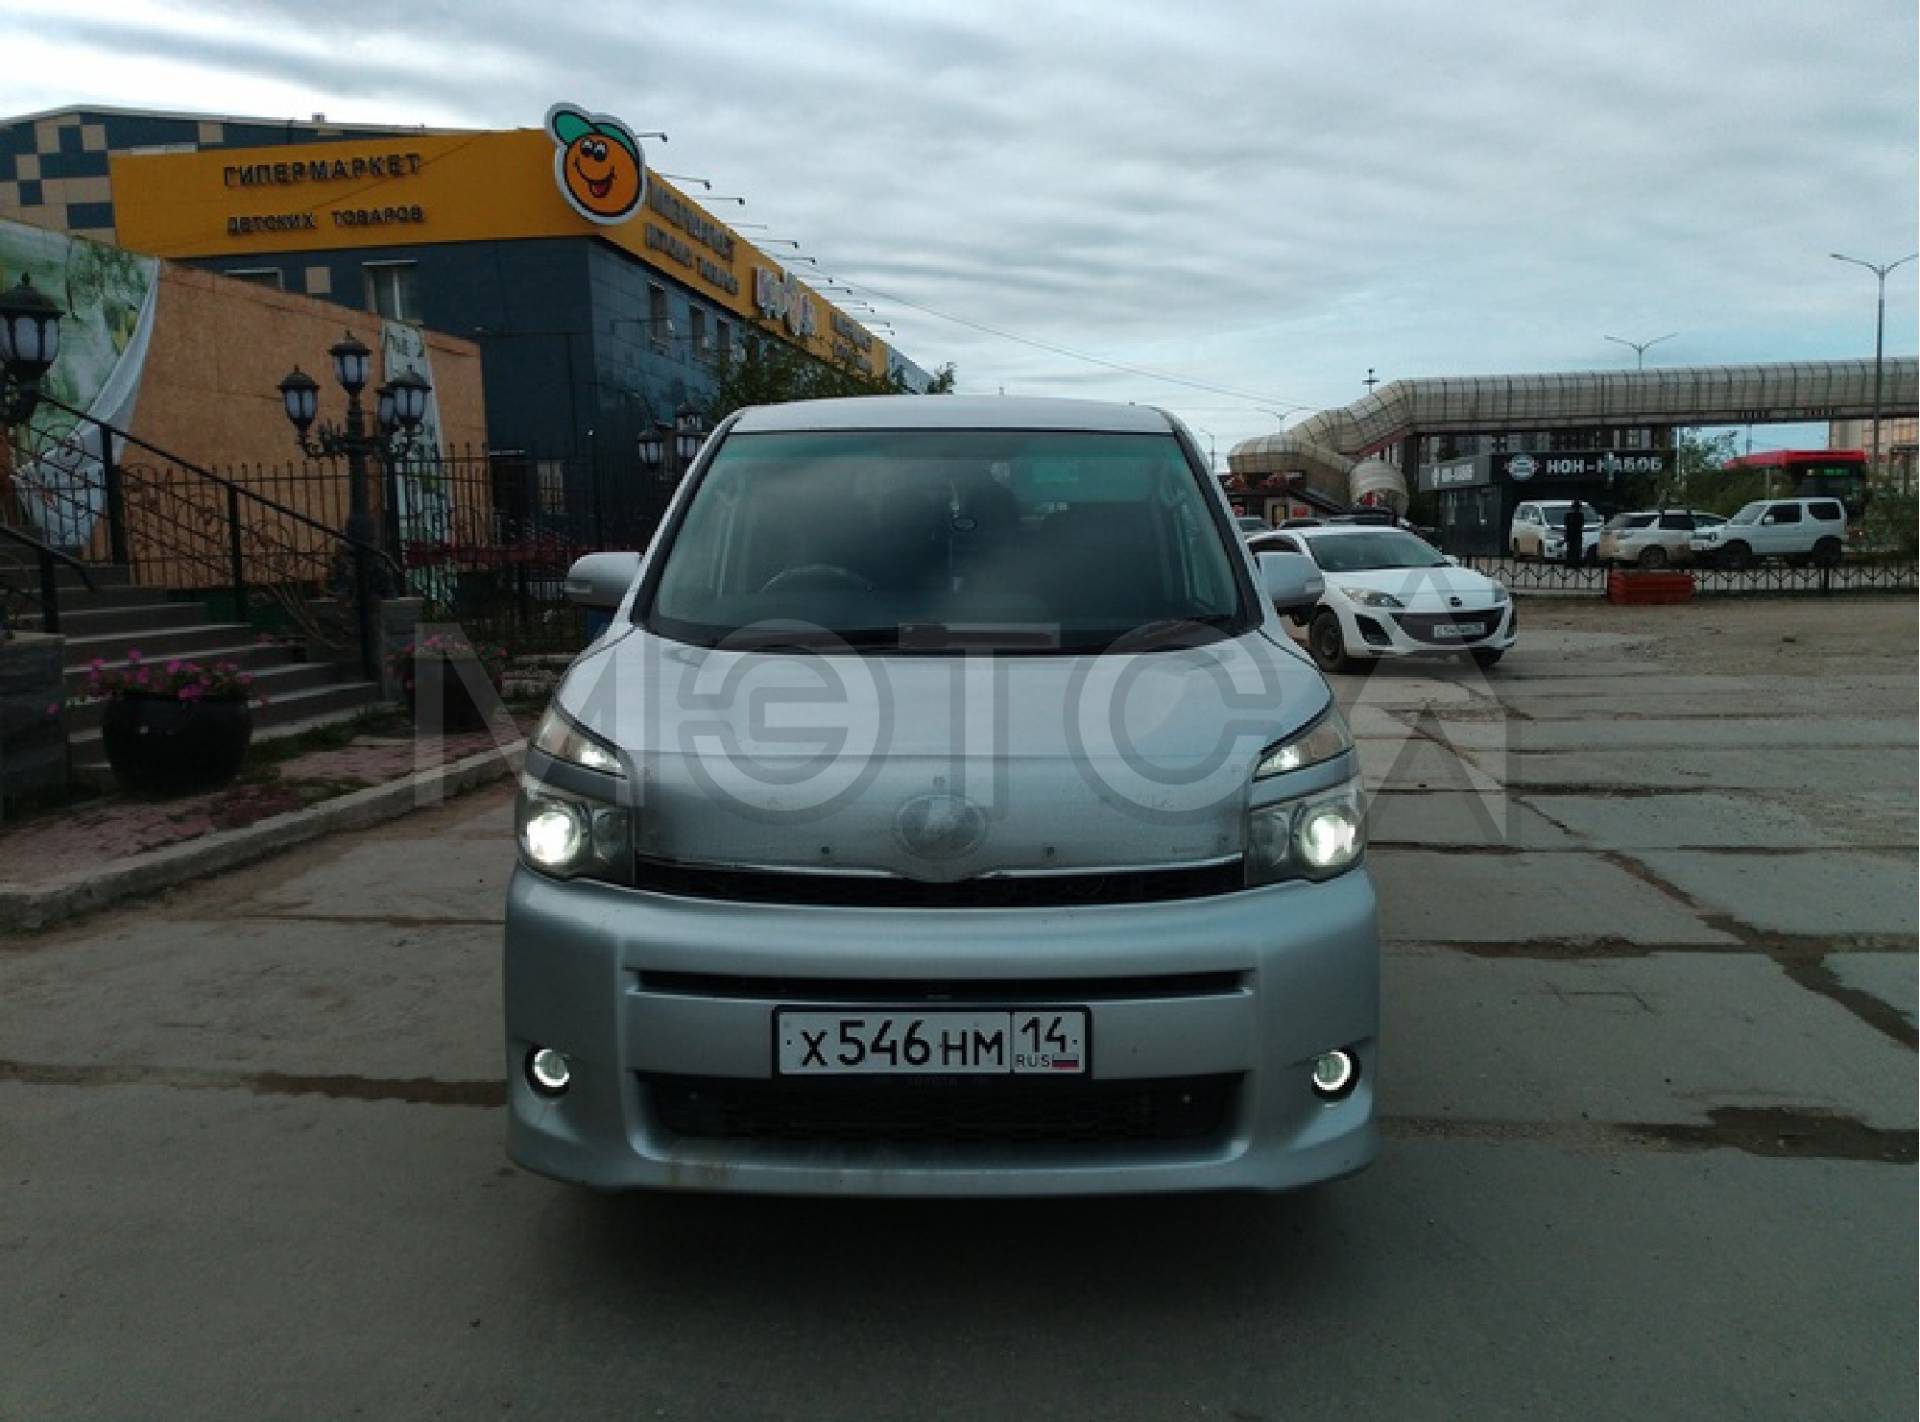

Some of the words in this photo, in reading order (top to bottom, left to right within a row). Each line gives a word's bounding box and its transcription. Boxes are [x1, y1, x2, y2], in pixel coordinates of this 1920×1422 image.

[223, 153, 421, 187] ГИПЕРМАРКЕТ
[227, 212, 317, 235] ДЕТСКИХ
[331, 204, 424, 225] ТОВАРОВ
[1022, 1016, 1067, 1053] 14
[1015, 1053, 1050, 1068] RUS
